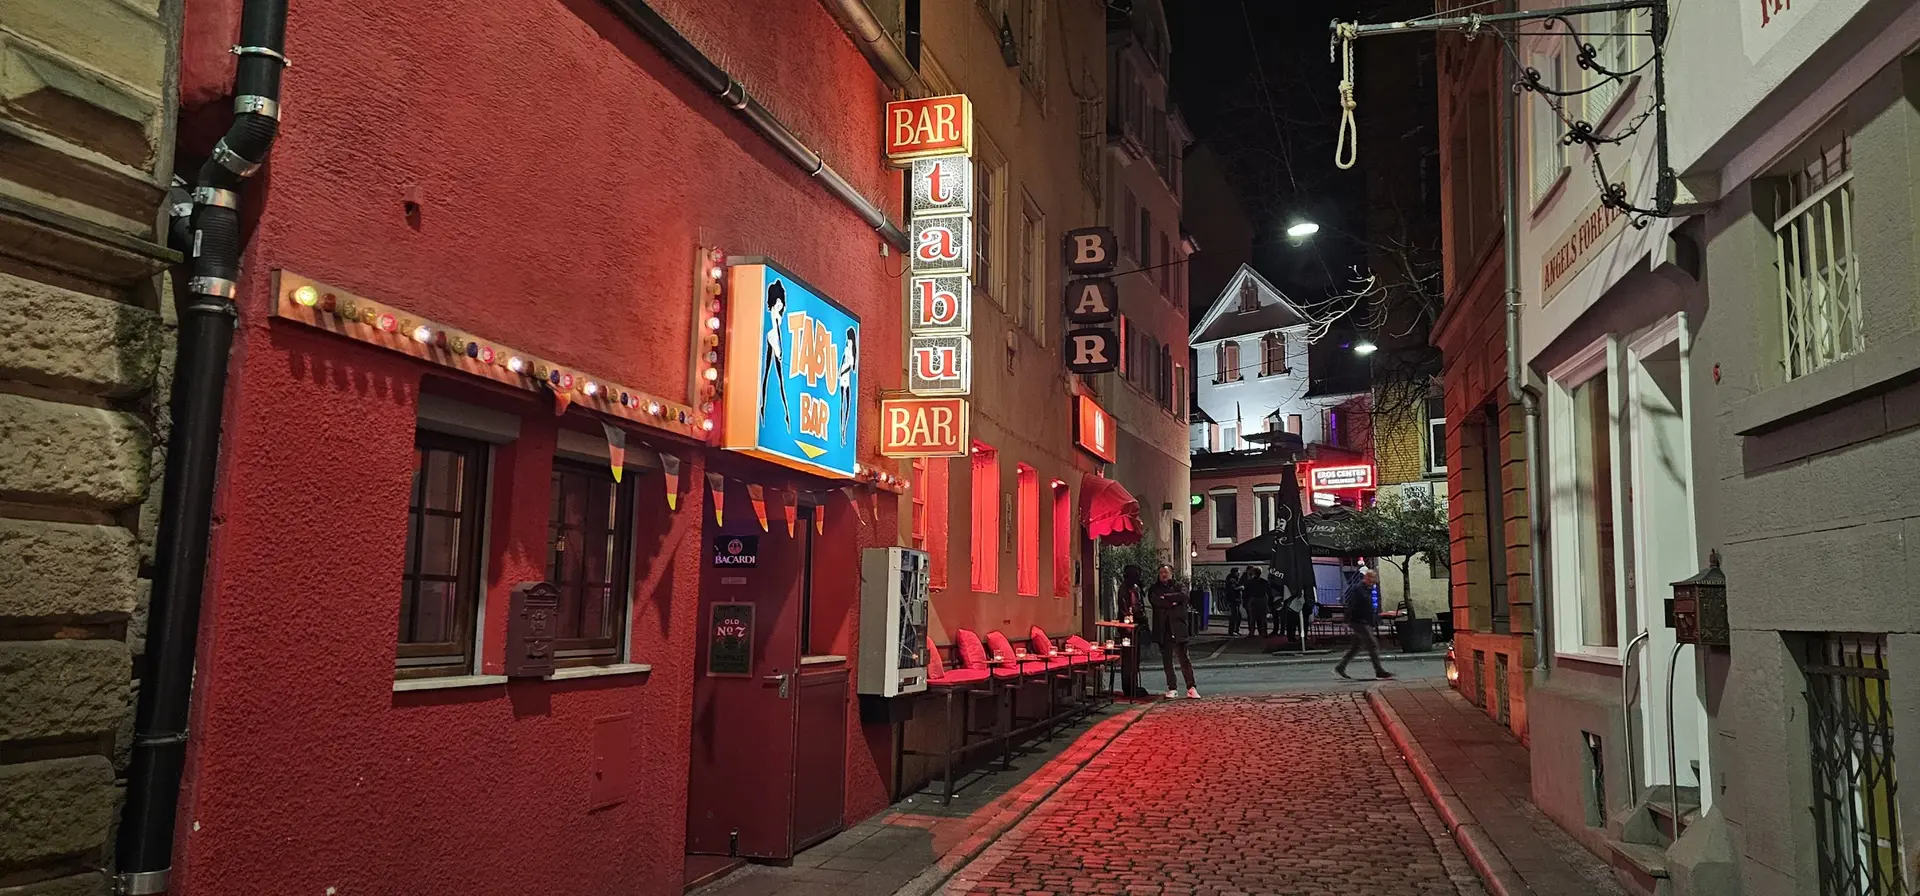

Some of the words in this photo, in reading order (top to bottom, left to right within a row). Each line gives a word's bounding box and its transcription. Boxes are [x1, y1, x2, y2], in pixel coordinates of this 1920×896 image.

[893, 104, 960, 147] BAR
[912, 160, 961, 380] tabu
[1544, 234, 1577, 291] ANGELS
[1579, 204, 1623, 257] FOREVE
[1073, 234, 1109, 365] BAR
[787, 311, 838, 396] TABU
[800, 393, 830, 441] BAR
[888, 406, 956, 448] BAR
[1317, 471, 1336, 479] EROS
[1337, 469, 1366, 477] CENTER
[715, 555, 756, 564] BACARDI
